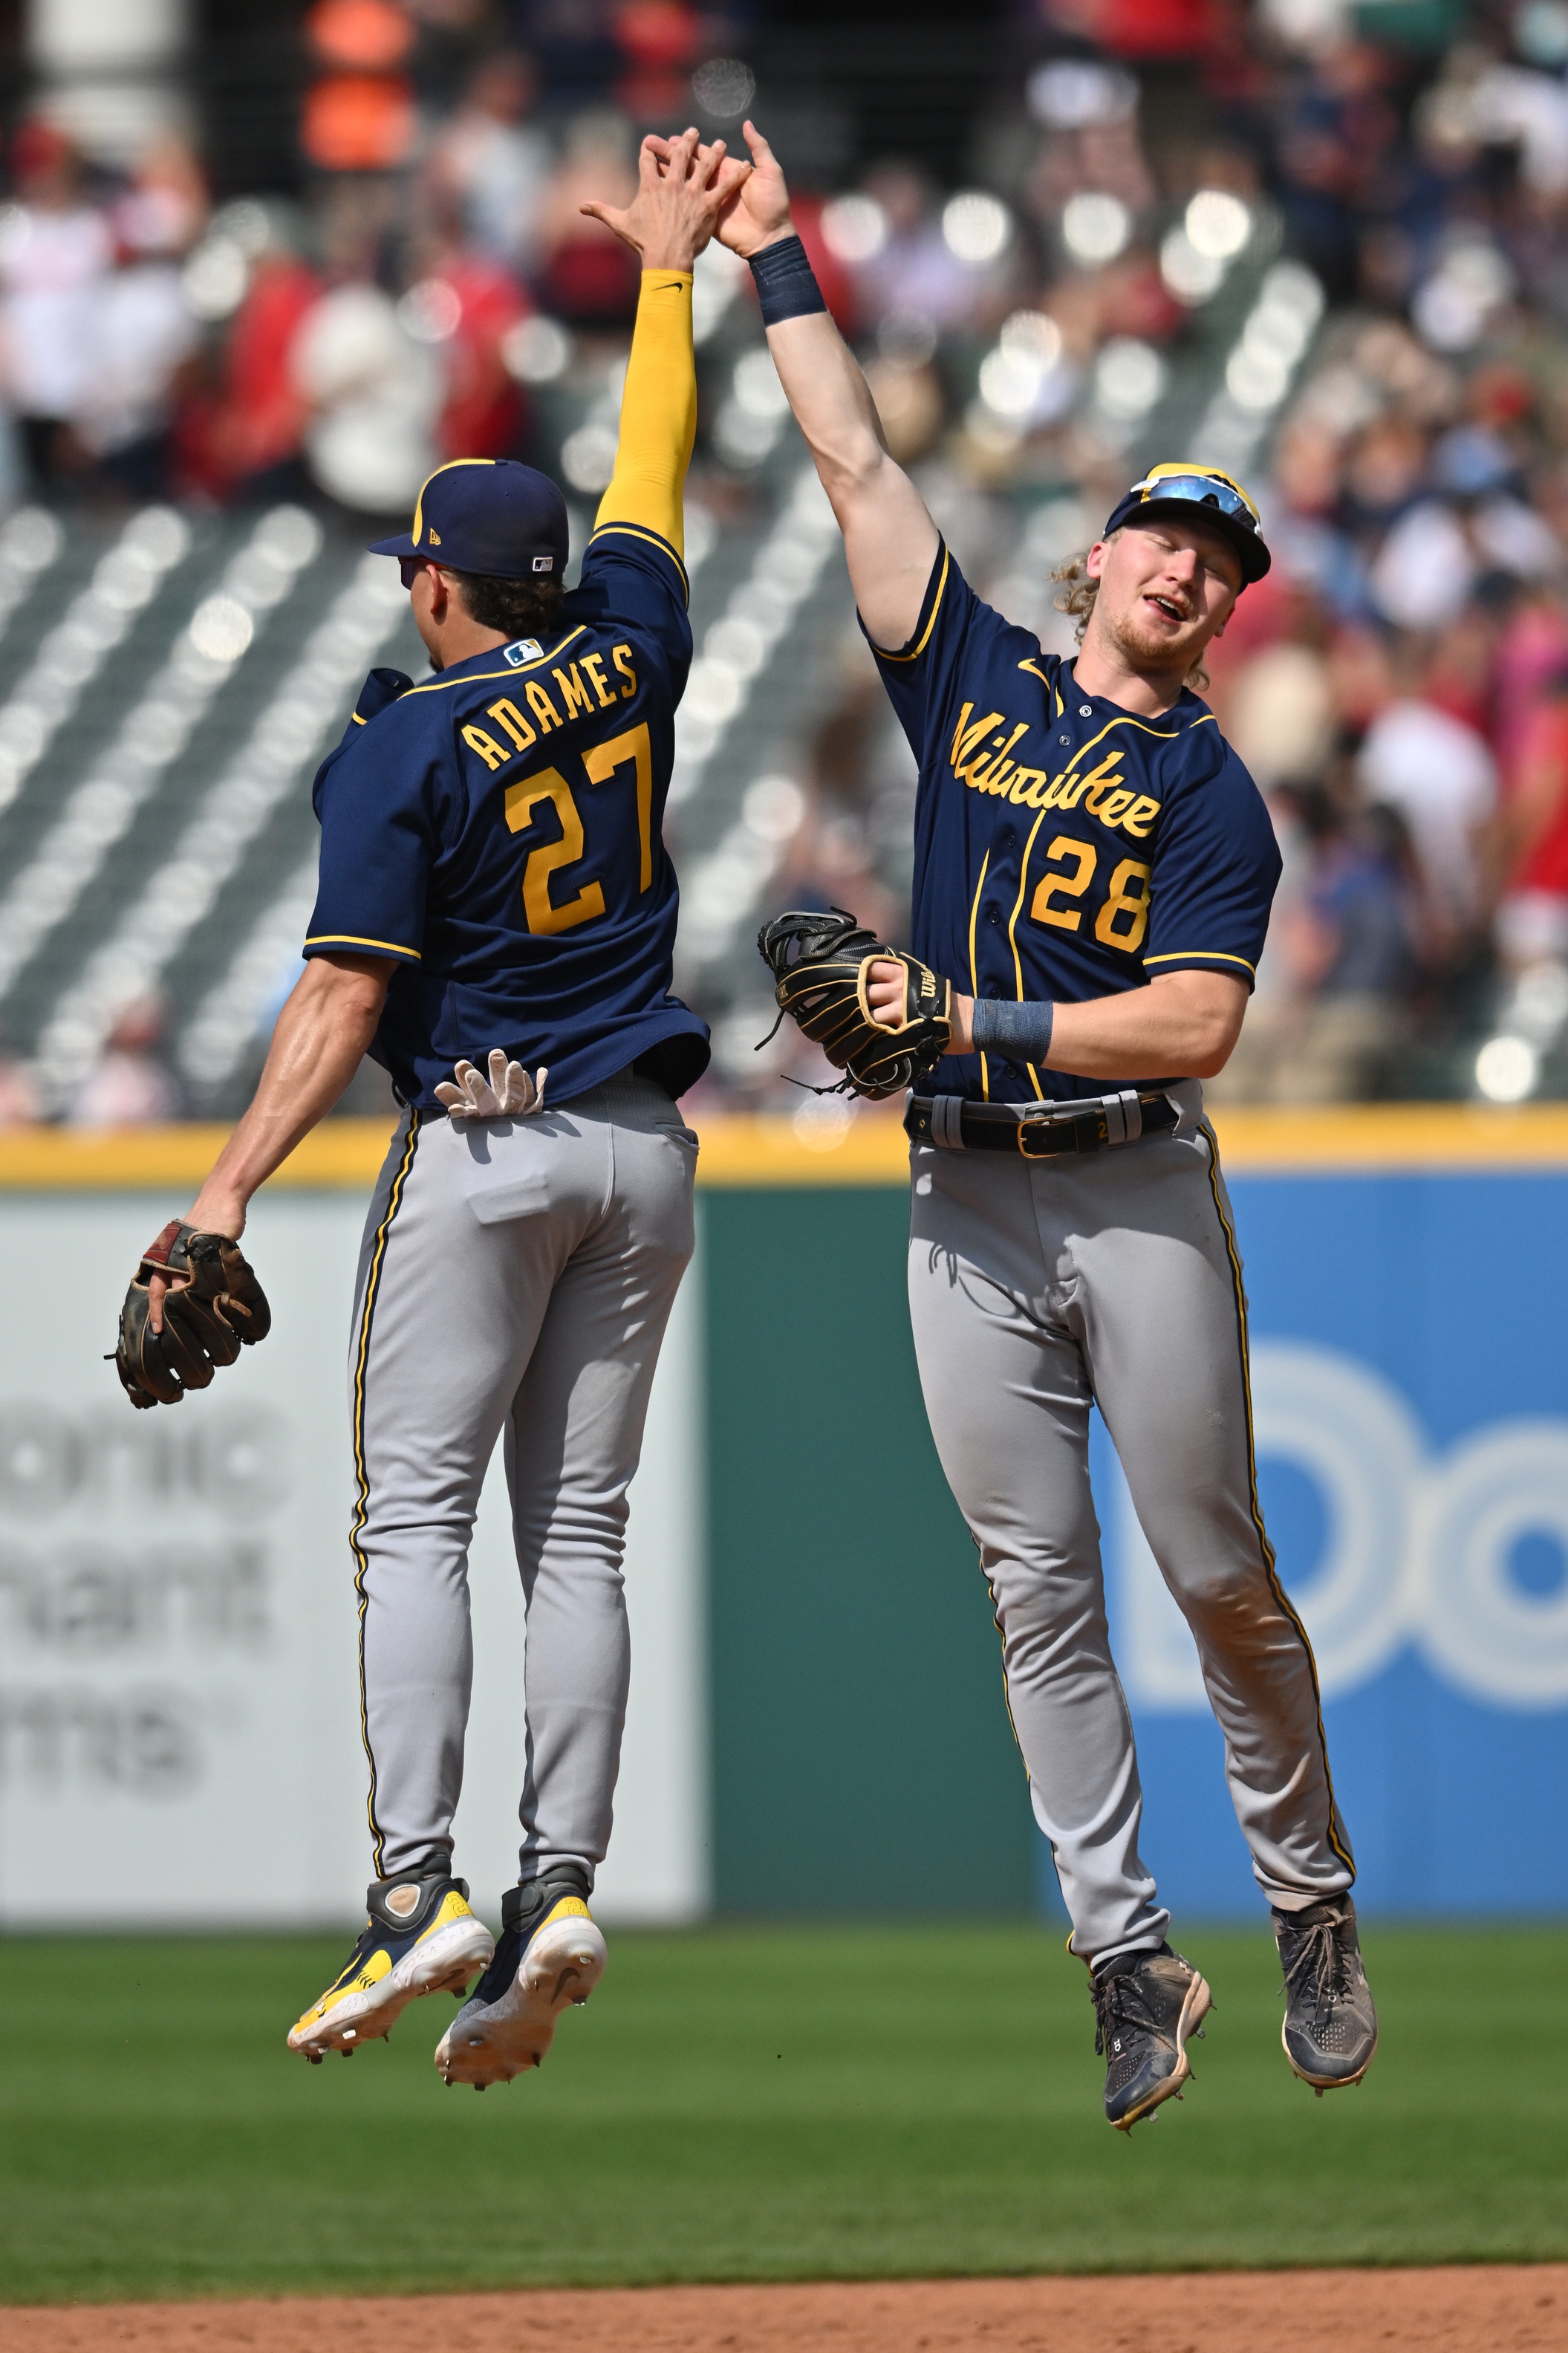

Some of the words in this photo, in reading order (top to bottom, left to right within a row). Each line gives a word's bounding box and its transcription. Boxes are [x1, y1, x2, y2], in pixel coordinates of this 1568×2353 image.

[461, 643, 637, 770] ADAMES
[949, 701, 1162, 838] Milwaukee
[504, 721, 653, 935] 27
[1029, 835, 1151, 954] 28
[920, 967, 937, 998] Wil
